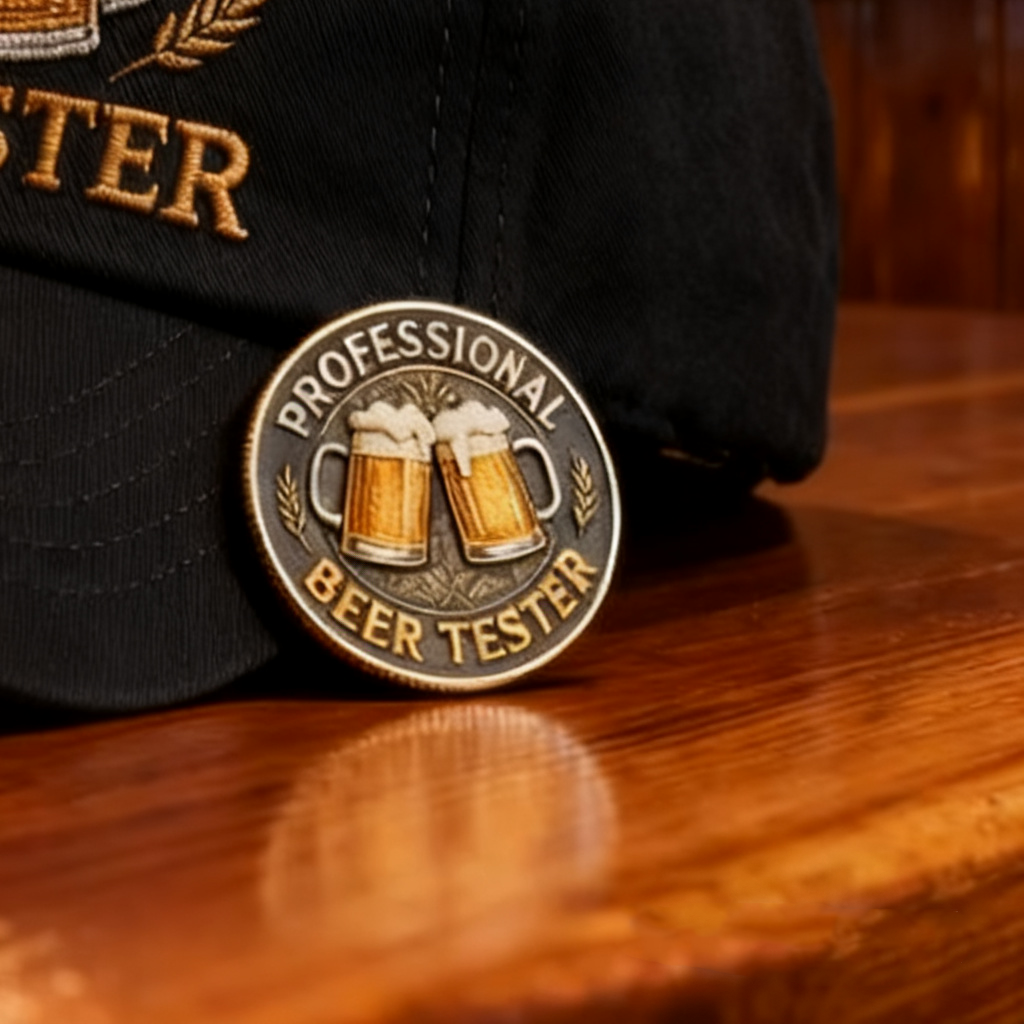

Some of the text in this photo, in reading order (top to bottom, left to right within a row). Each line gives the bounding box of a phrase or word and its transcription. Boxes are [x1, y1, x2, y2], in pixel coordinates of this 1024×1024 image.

[277, 319, 565, 437] PROFESSIONAL
[305, 549, 597, 664] BEER TESTER
